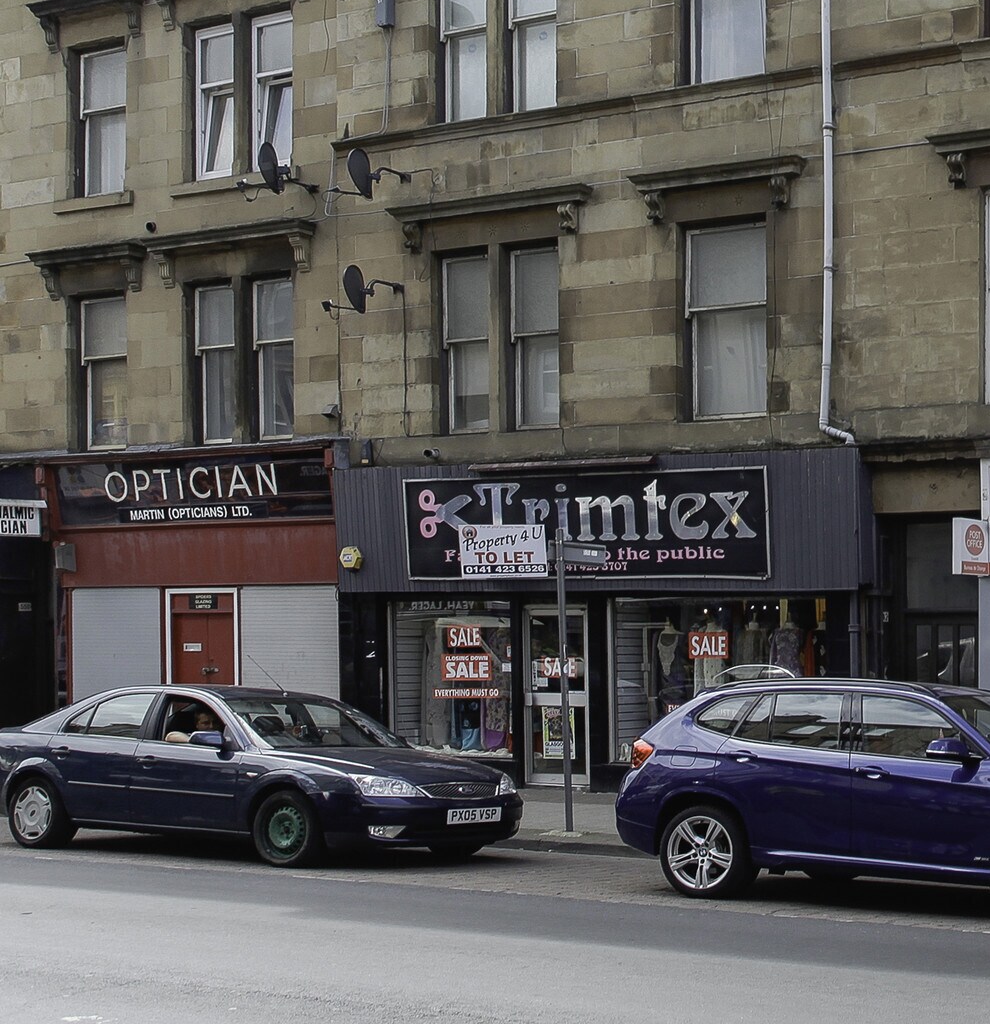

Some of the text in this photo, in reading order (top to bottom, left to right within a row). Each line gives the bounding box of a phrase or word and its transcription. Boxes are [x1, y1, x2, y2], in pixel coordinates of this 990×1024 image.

[104, 463, 278, 502] OPTICIAN
[0, 506, 34, 520] ALMIC
[130, 505, 252, 521] MARTIN (OPTICIANS) LTD.
[473, 479, 757, 541] Trimtex
[463, 526, 543, 552] Property 4 U
[969, 530, 981, 540] POST
[966, 539, 983, 549] OFFICE
[475, 552, 498, 564] TO
[504, 551, 534, 563] LET
[618, 546, 650, 560] the
[656, 546, 726, 563] public
[466, 566, 491, 574] 0141
[518, 565, 544, 573] 6526
[450, 627, 480, 647] SALE
[691, 636, 726, 656] SALE
[445, 662, 489, 679] SALE
[544, 657, 576, 677] SAE
[434, 689, 470, 697] EVERYTHING
[489, 688, 499, 696] GO
[451, 808, 497, 822] PX05 VSP
